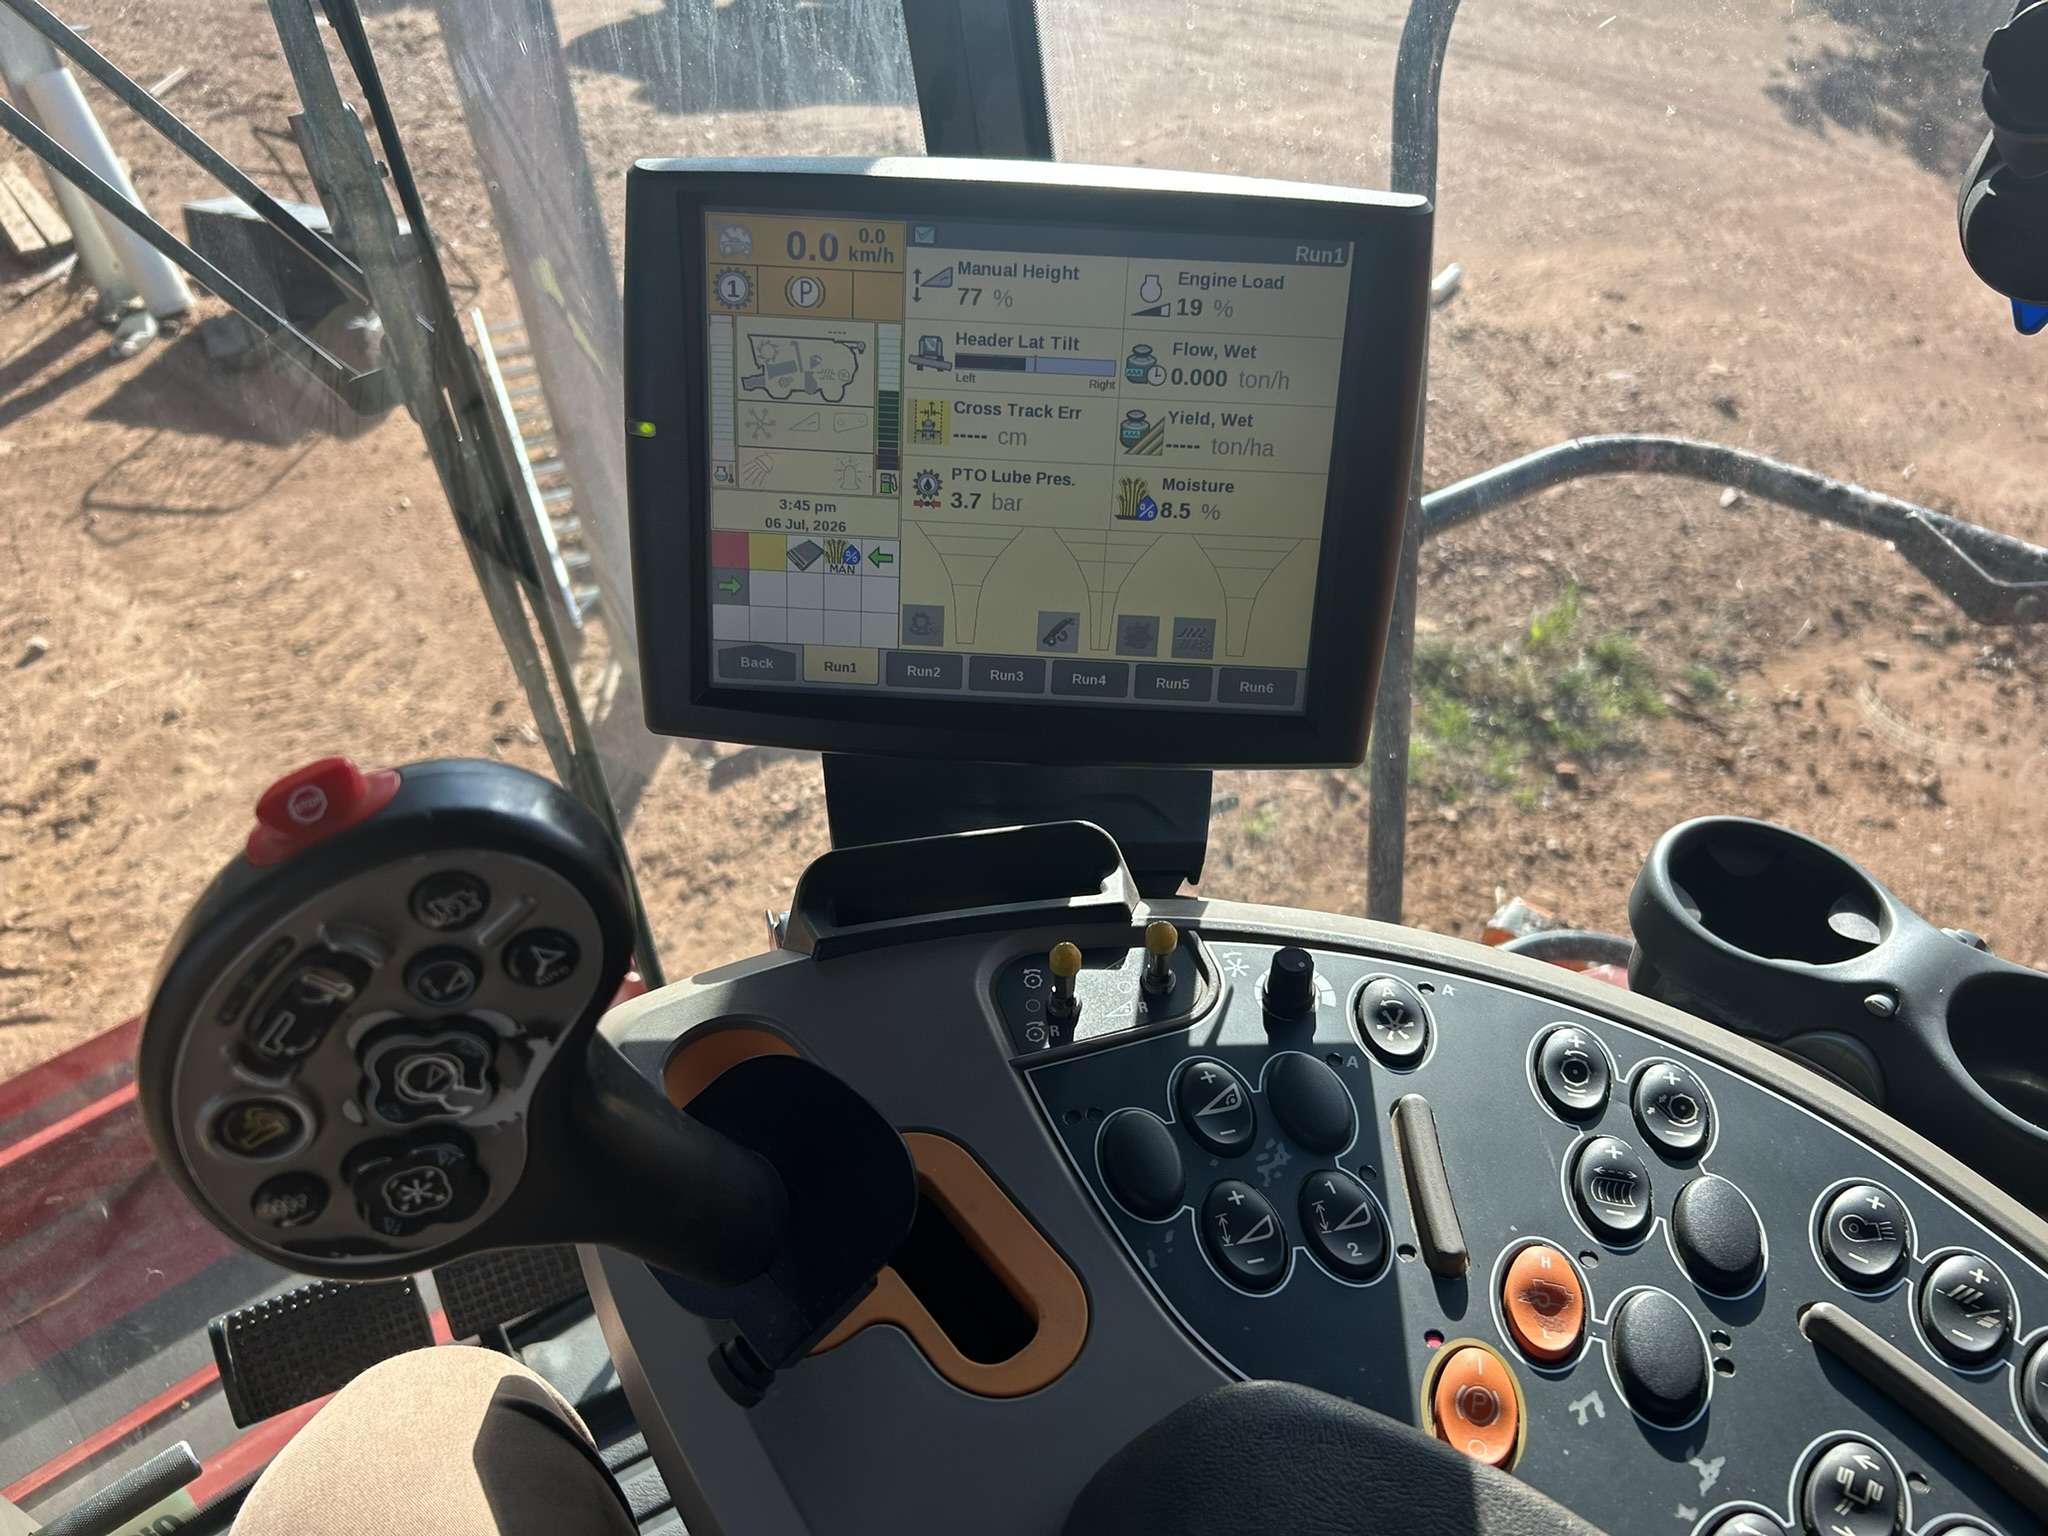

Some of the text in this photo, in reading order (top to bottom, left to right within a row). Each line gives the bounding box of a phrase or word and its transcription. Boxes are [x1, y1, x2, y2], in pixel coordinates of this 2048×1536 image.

[859, 227, 886, 244] 0.0
[786, 230, 839, 262] 0.0
[848, 246, 894, 263] km/h
[1295, 246, 1344, 264] Run1
[958, 261, 1080, 283] Manual Height
[1178, 272, 1285, 290] Engine Load
[727, 280, 740, 298] 1
[958, 287, 1013, 308] 77 %
[1177, 299, 1234, 318] 19 %
[956, 332, 1080, 350] Header Lat Tilt
[1173, 342, 1257, 359] Flow, Wet
[956, 373, 975, 383] Left
[1089, 380, 1116, 390] Right
[1171, 368, 1290, 390] 0.000 ton/h
[954, 400, 1082, 420] Cross Track Err
[1168, 411, 1254, 427] Yield, Wet
[998, 431, 1027, 445] cm
[1211, 438, 1274, 457] ton/ha
[952, 468, 1075, 486] PTO Lube Pres.
[1162, 478, 1235, 493] Moisture
[779, 499, 836, 515] 3:45 pm
[951, 492, 1023, 512] 3.7 bar
[1160, 503, 1220, 520] 8.5 %
[765, 518, 846, 532] 06 Jul, 2026
[830, 564, 855, 574] MAN
[740, 656, 774, 669] Back
[824, 661, 857, 673] Run1
[907, 665, 941, 678] Run2
[989, 669, 1024, 682] Run3
[1072, 673, 1107, 686] Run4
[1156, 677, 1190, 690] Run5
[1240, 681, 1274, 694] Run6
[1382, 987, 1395, 997] A
[1442, 984, 1454, 996] A
[1139, 1002, 1148, 1012] R
[1050, 1025, 1060, 1036] R
[1346, 1056, 1359, 1068] A
[1324, 1181, 1337, 1194] 1
[1347, 1242, 1362, 1256] 2
[1541, 1257, 1551, 1269] H
